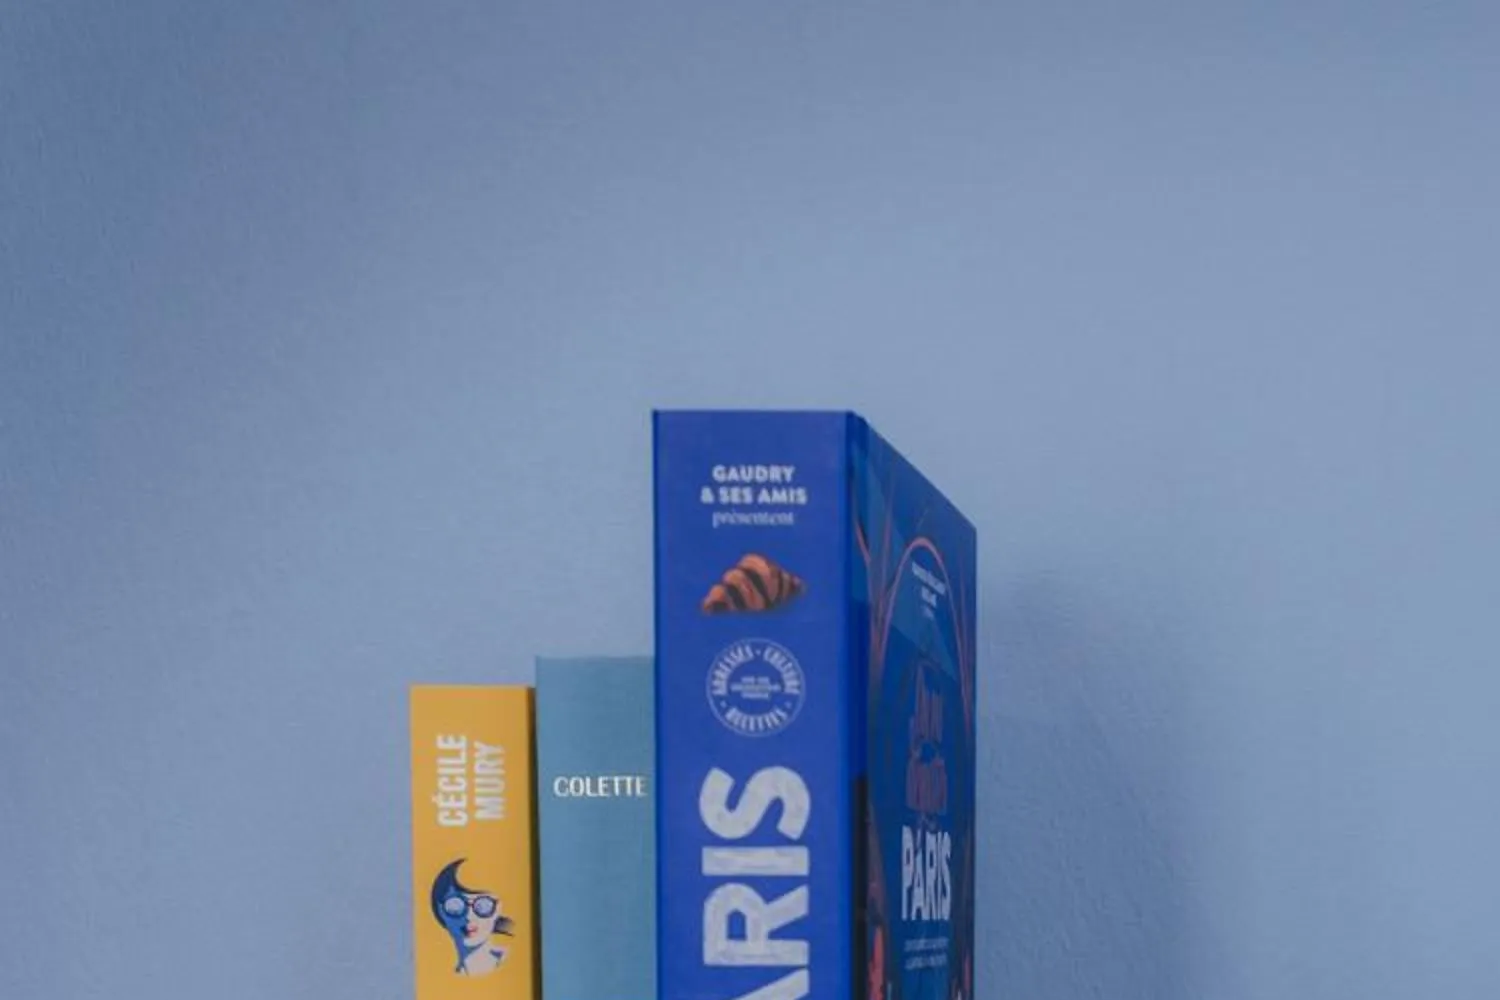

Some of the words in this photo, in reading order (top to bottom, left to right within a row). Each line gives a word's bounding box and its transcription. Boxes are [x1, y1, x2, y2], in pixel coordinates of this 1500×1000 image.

[712, 464, 795, 483] GAUDRY
[719, 486, 753, 504] SES
[757, 486, 808, 505] AMIS
[432, 733, 468, 828] CÉCILE
[474, 741, 505, 820] MURY
[553, 776, 648, 798] COLETTE
[901, 825, 952, 921] PARIS
